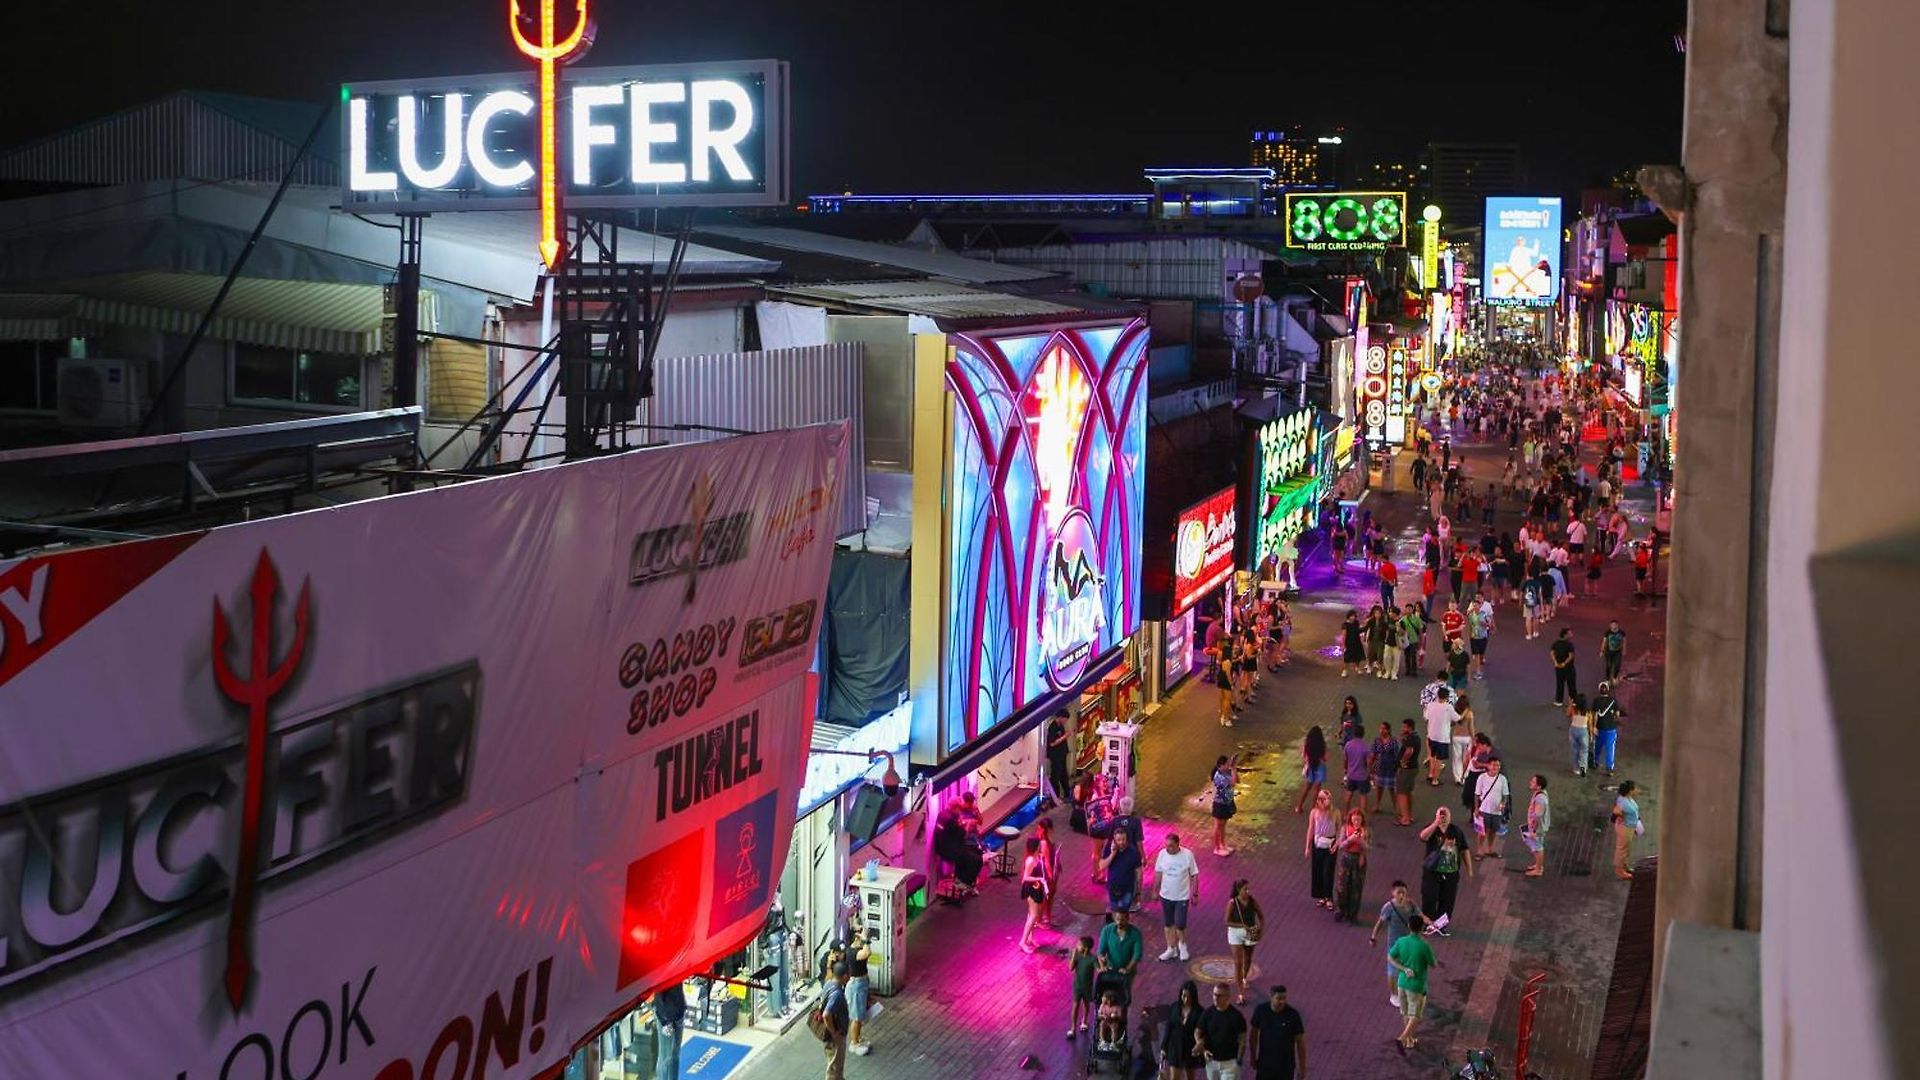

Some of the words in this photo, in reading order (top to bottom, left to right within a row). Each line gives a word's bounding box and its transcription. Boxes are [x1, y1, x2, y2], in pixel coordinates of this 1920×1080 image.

[1293, 198, 1399, 241] 808
[1307, 242, 1326, 250] FIRST
[1328, 242, 1348, 250] CLASS
[1525, 298, 1556, 307] STREET
[0, 562, 51, 657] Y
[1039, 585, 1106, 664] AURA
[627, 666, 717, 735] SHOP
[654, 709, 762, 823] TUNNEL
[0, 688, 467, 967] UCIFER
[174, 966, 378, 1080] OOK
